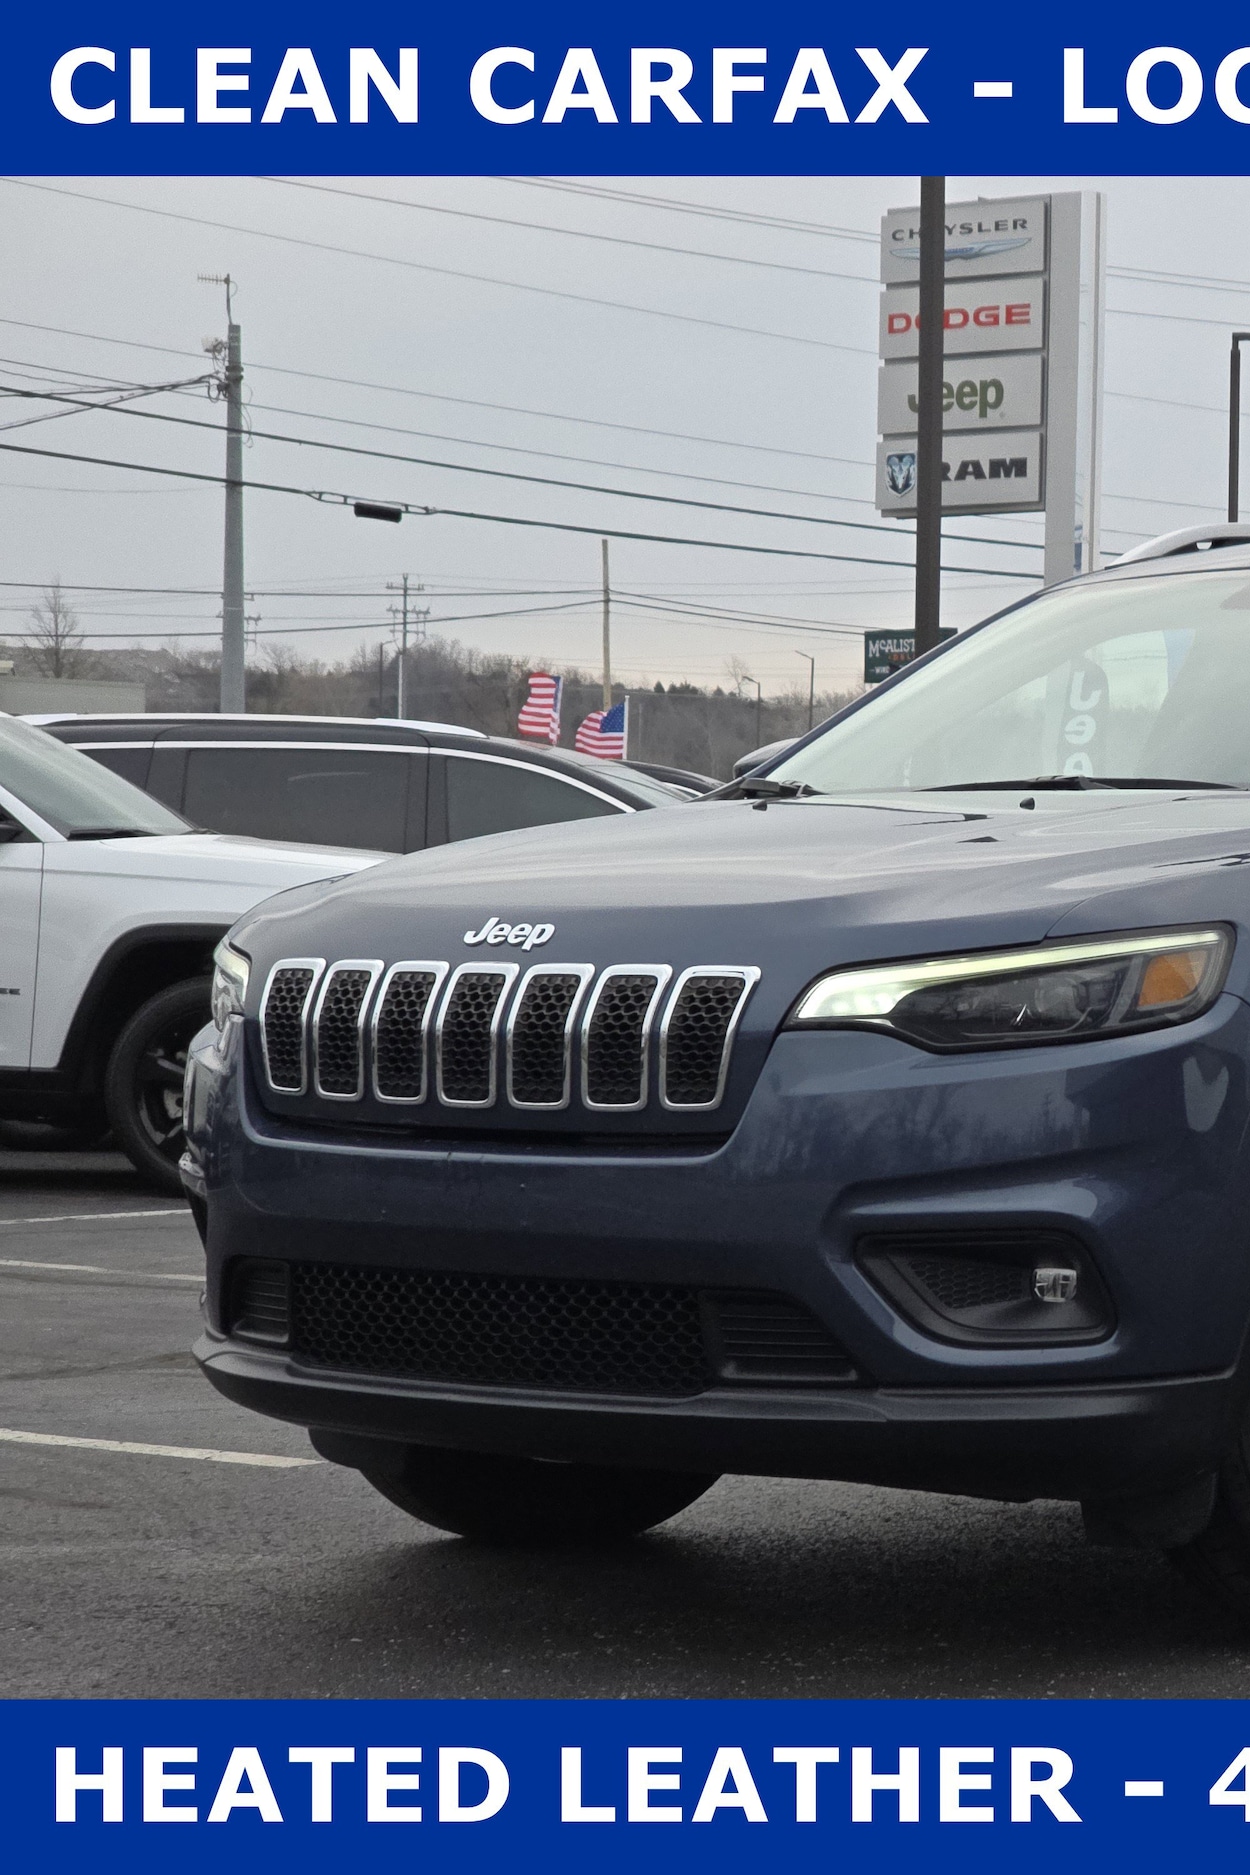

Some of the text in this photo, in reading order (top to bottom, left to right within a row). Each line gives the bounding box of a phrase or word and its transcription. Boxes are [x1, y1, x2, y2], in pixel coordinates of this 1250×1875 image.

[891, 217, 1028, 242] CHYSLER
[887, 303, 1031, 335] DDGE
[868, 639, 915, 657] McALIST
[463, 916, 556, 952] Jeep
